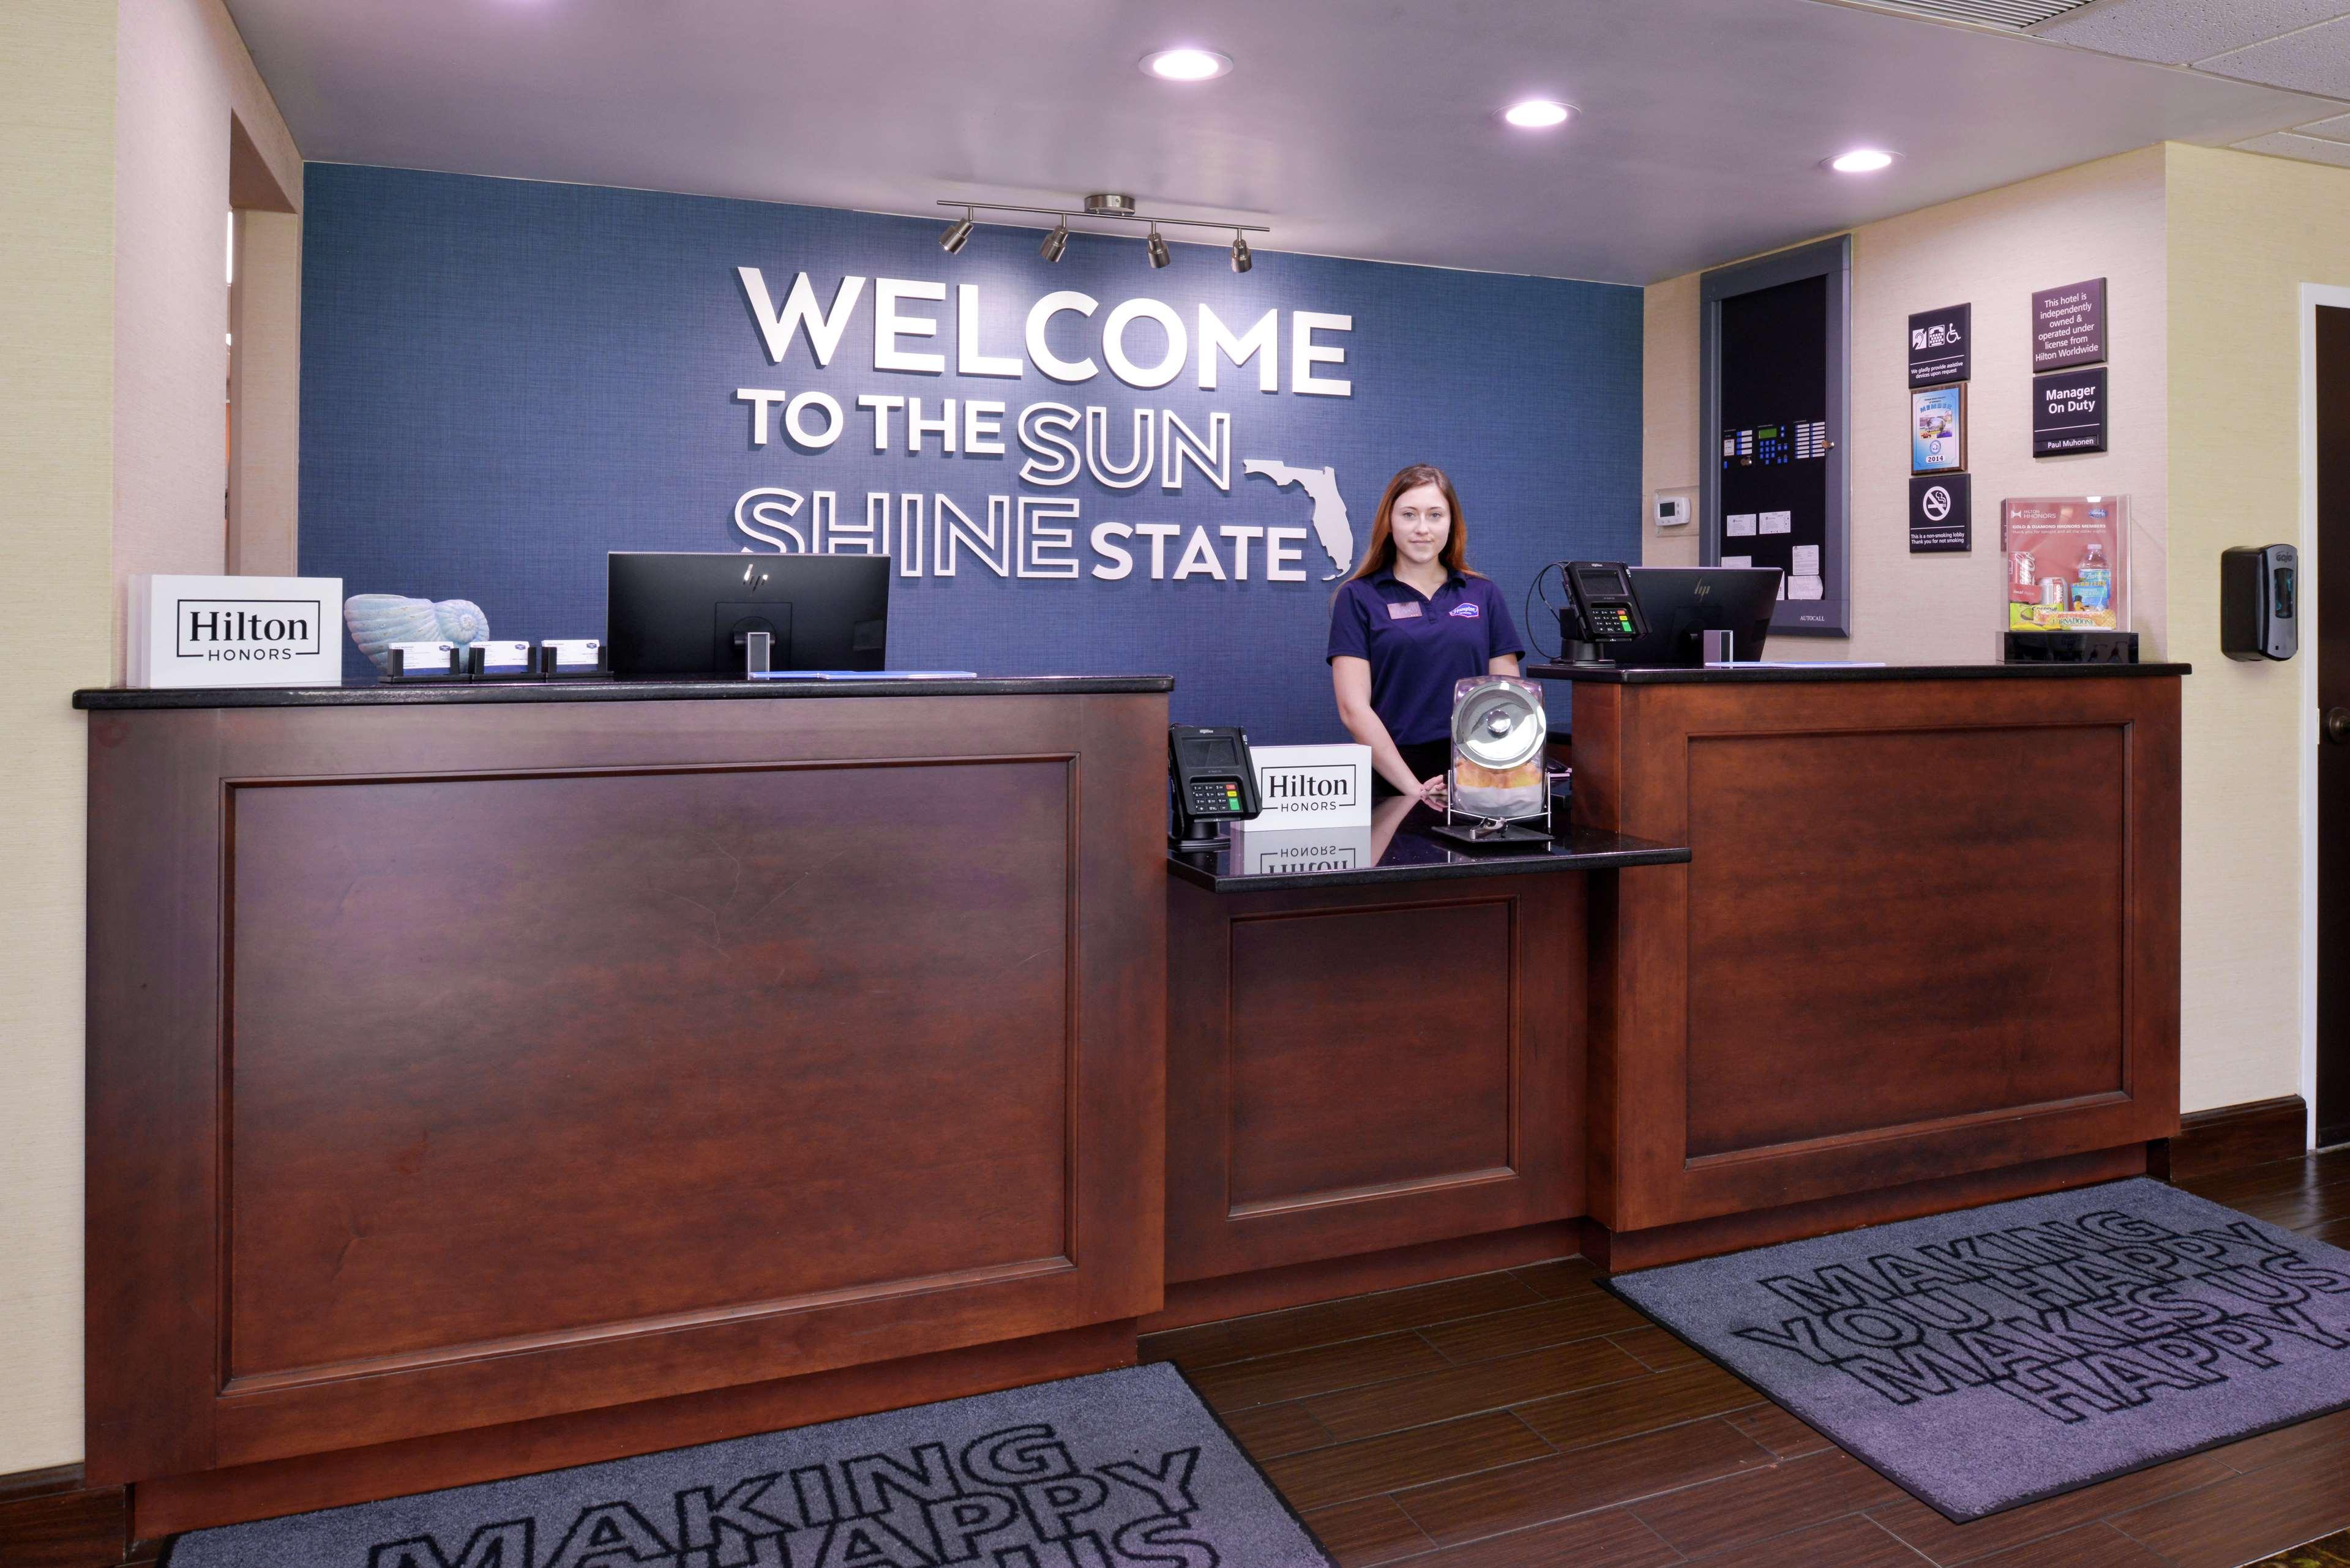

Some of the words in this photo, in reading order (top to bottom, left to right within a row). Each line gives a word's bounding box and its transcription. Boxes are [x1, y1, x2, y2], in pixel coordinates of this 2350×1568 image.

[2045, 299, 2059, 308] This
[2060, 293, 2079, 305] hotel
[2081, 292, 2087, 301] is
[2040, 302, 2092, 319] independently
[2049, 316, 2074, 327] owned
[2076, 314, 2082, 323] &
[738, 266, 1352, 396] WELCOME
[2038, 327, 2070, 341] operated
[2072, 324, 2095, 334] under
[2045, 340, 2068, 349] license
[2070, 336, 2088, 345] from
[2035, 352, 2057, 362] Hilton
[2058, 343, 2098, 357] Worldwide
[2046, 386, 2096, 401] Manager
[2048, 403, 2065, 414] On
[2068, 400, 2096, 413] Duty
[736, 387, 845, 448] TO
[858, 394, 1006, 454] THE
[1017, 401, 1230, 490] SUN
[2063, 439, 2094, 447] Muhonen
[734, 487, 1080, 578] SHINE
[1090, 521, 1308, 582] STATE
[1694, 577, 1711, 603] hp
[189, 611, 309, 641] Hilton
[209, 648, 291, 661] HONORS
[1268, 774, 1349, 798] Hilton
[1281, 801, 1337, 812] HONORS
[1756, 1210, 2179, 1317] MAKING
[1730, 1286, 1996, 1366] YOU
[1972, 1221, 2300, 1312] HAPPY
[1836, 1285, 2230, 1406] MAKES
[2193, 1255, 2350, 1306] US
[367, 1423, 1079, 1568] MAKING
